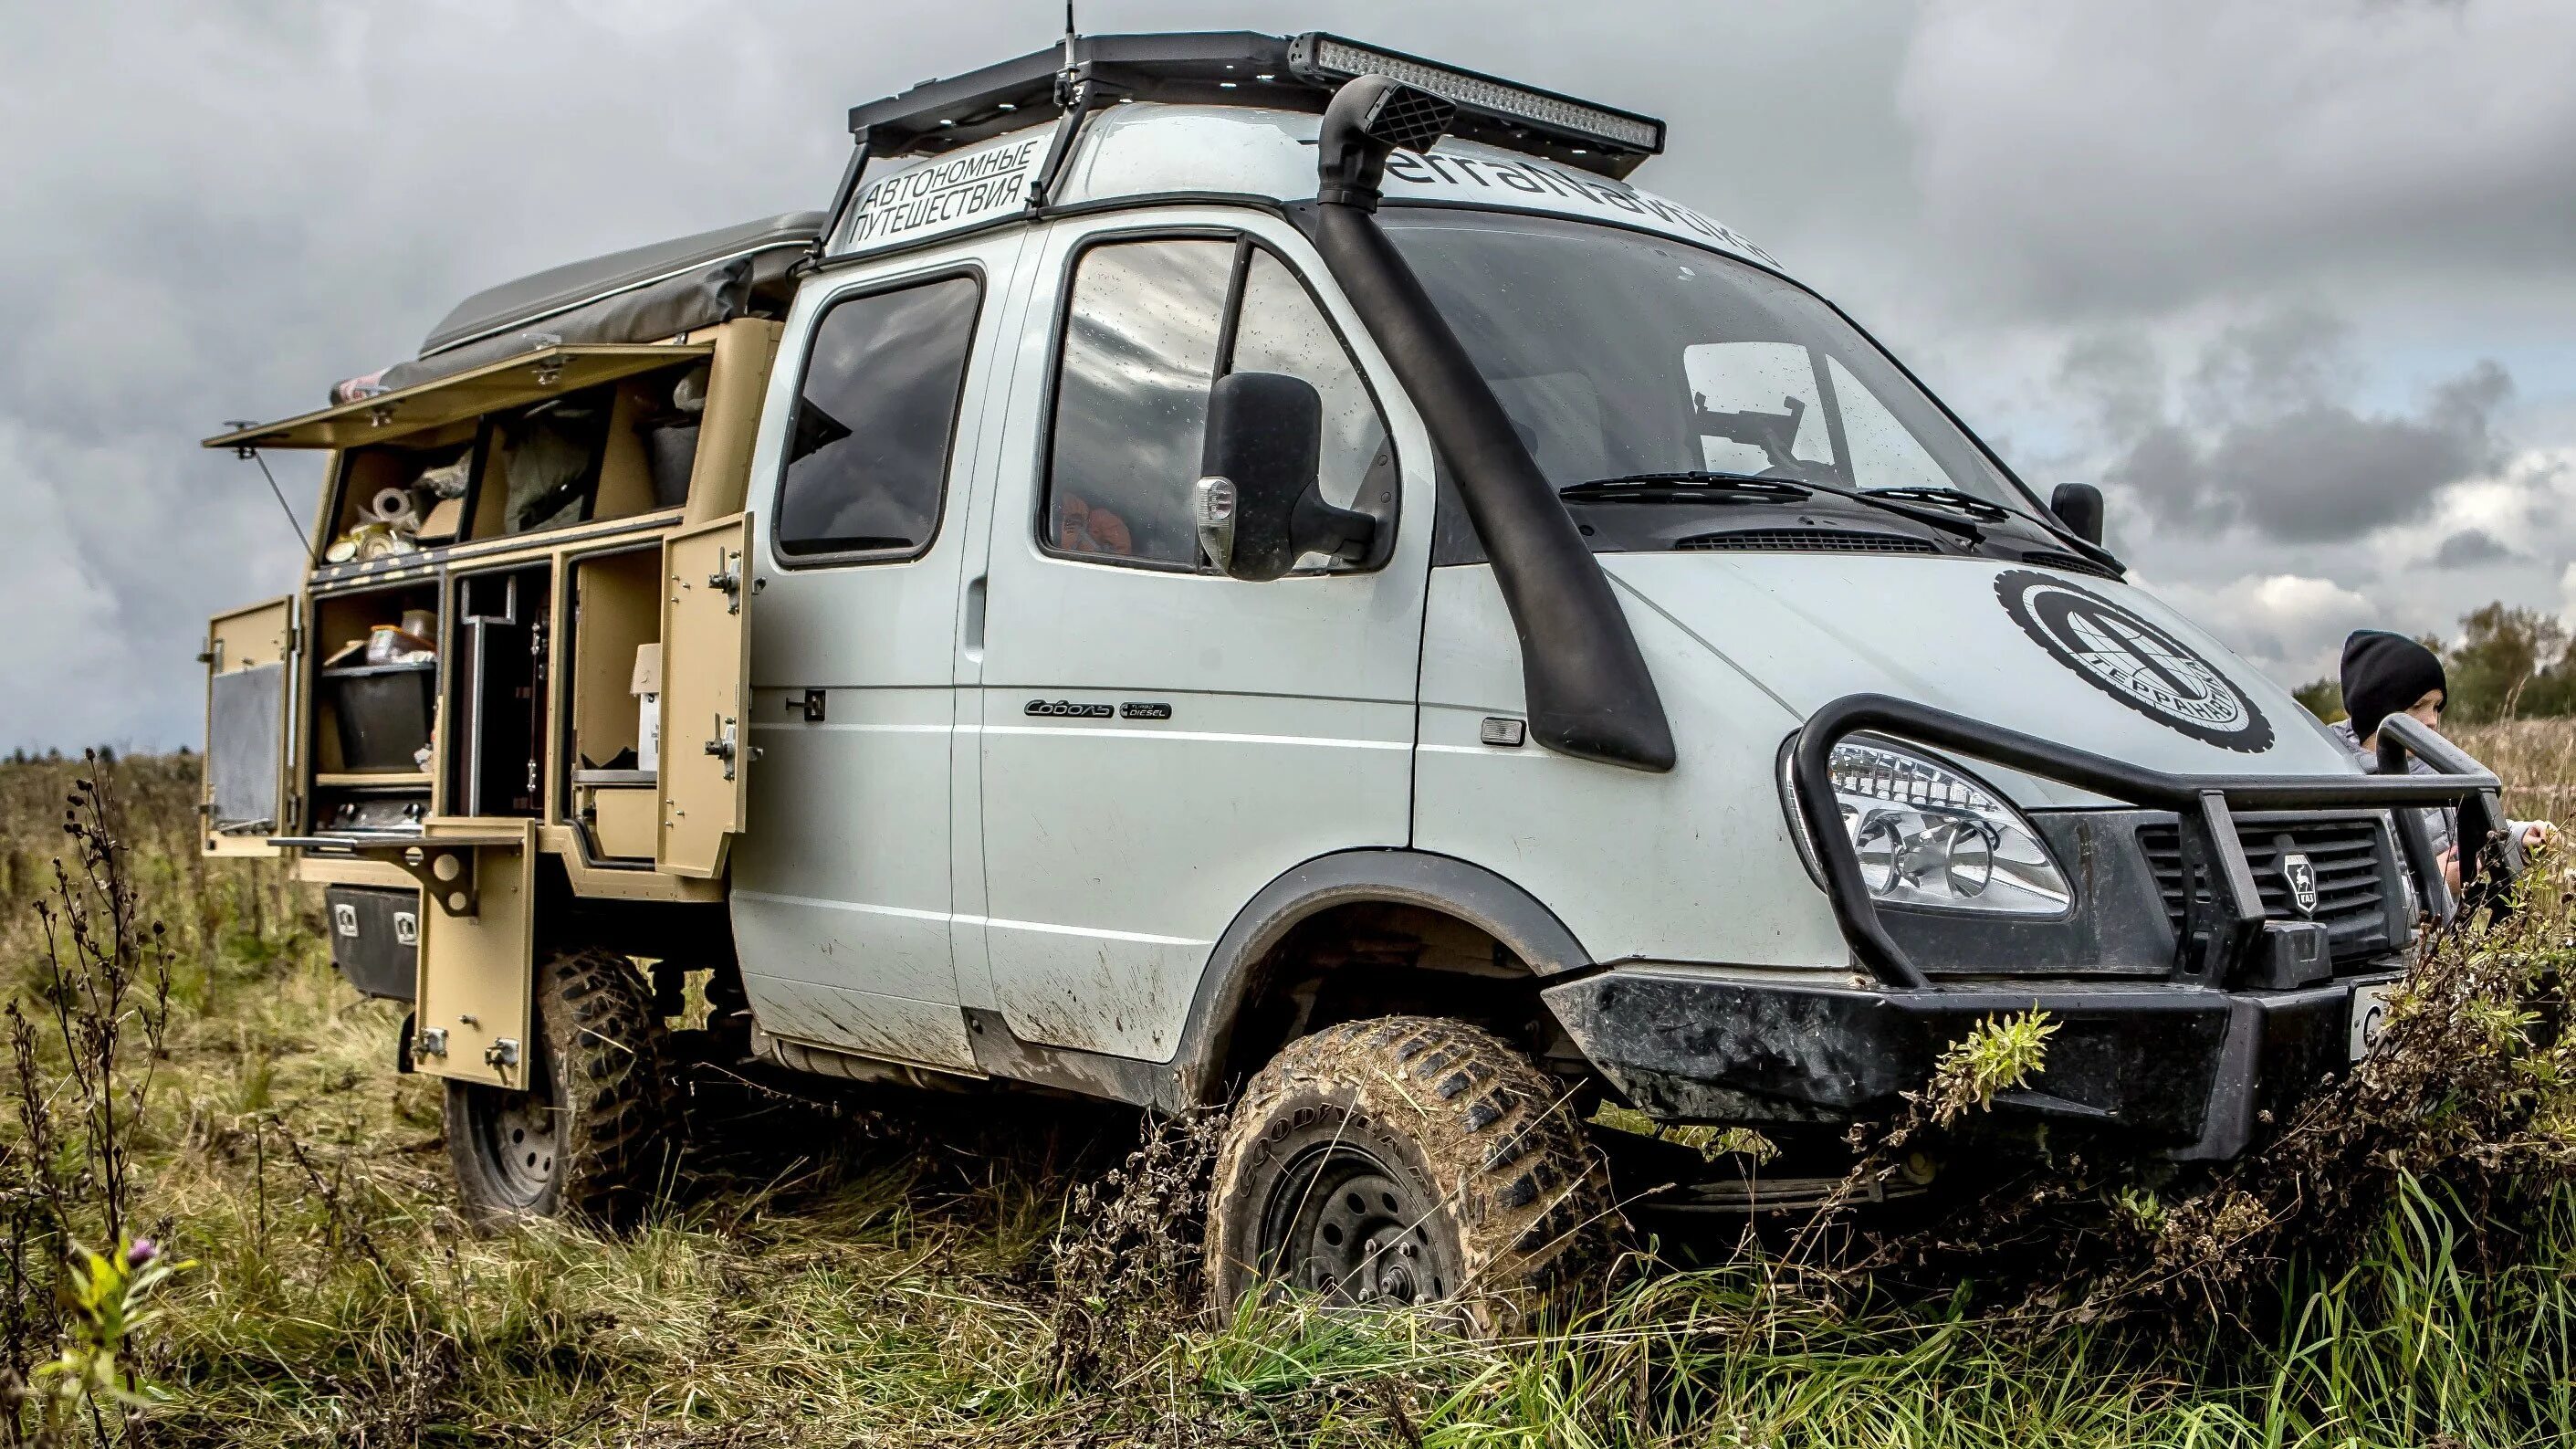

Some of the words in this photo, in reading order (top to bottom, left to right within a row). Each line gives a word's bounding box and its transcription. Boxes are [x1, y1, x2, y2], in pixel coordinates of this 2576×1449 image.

[849, 173, 1024, 244] ПУТЕШЕСТВИЯ
[861, 141, 1039, 211] АВТОНОМНЫЕ
[1296, 140, 1785, 269] erraNavtika
[2090, 654, 2234, 720] ТЕРРАНАВТИКА
[1239, 1103, 1431, 1198] GOODYEAR
